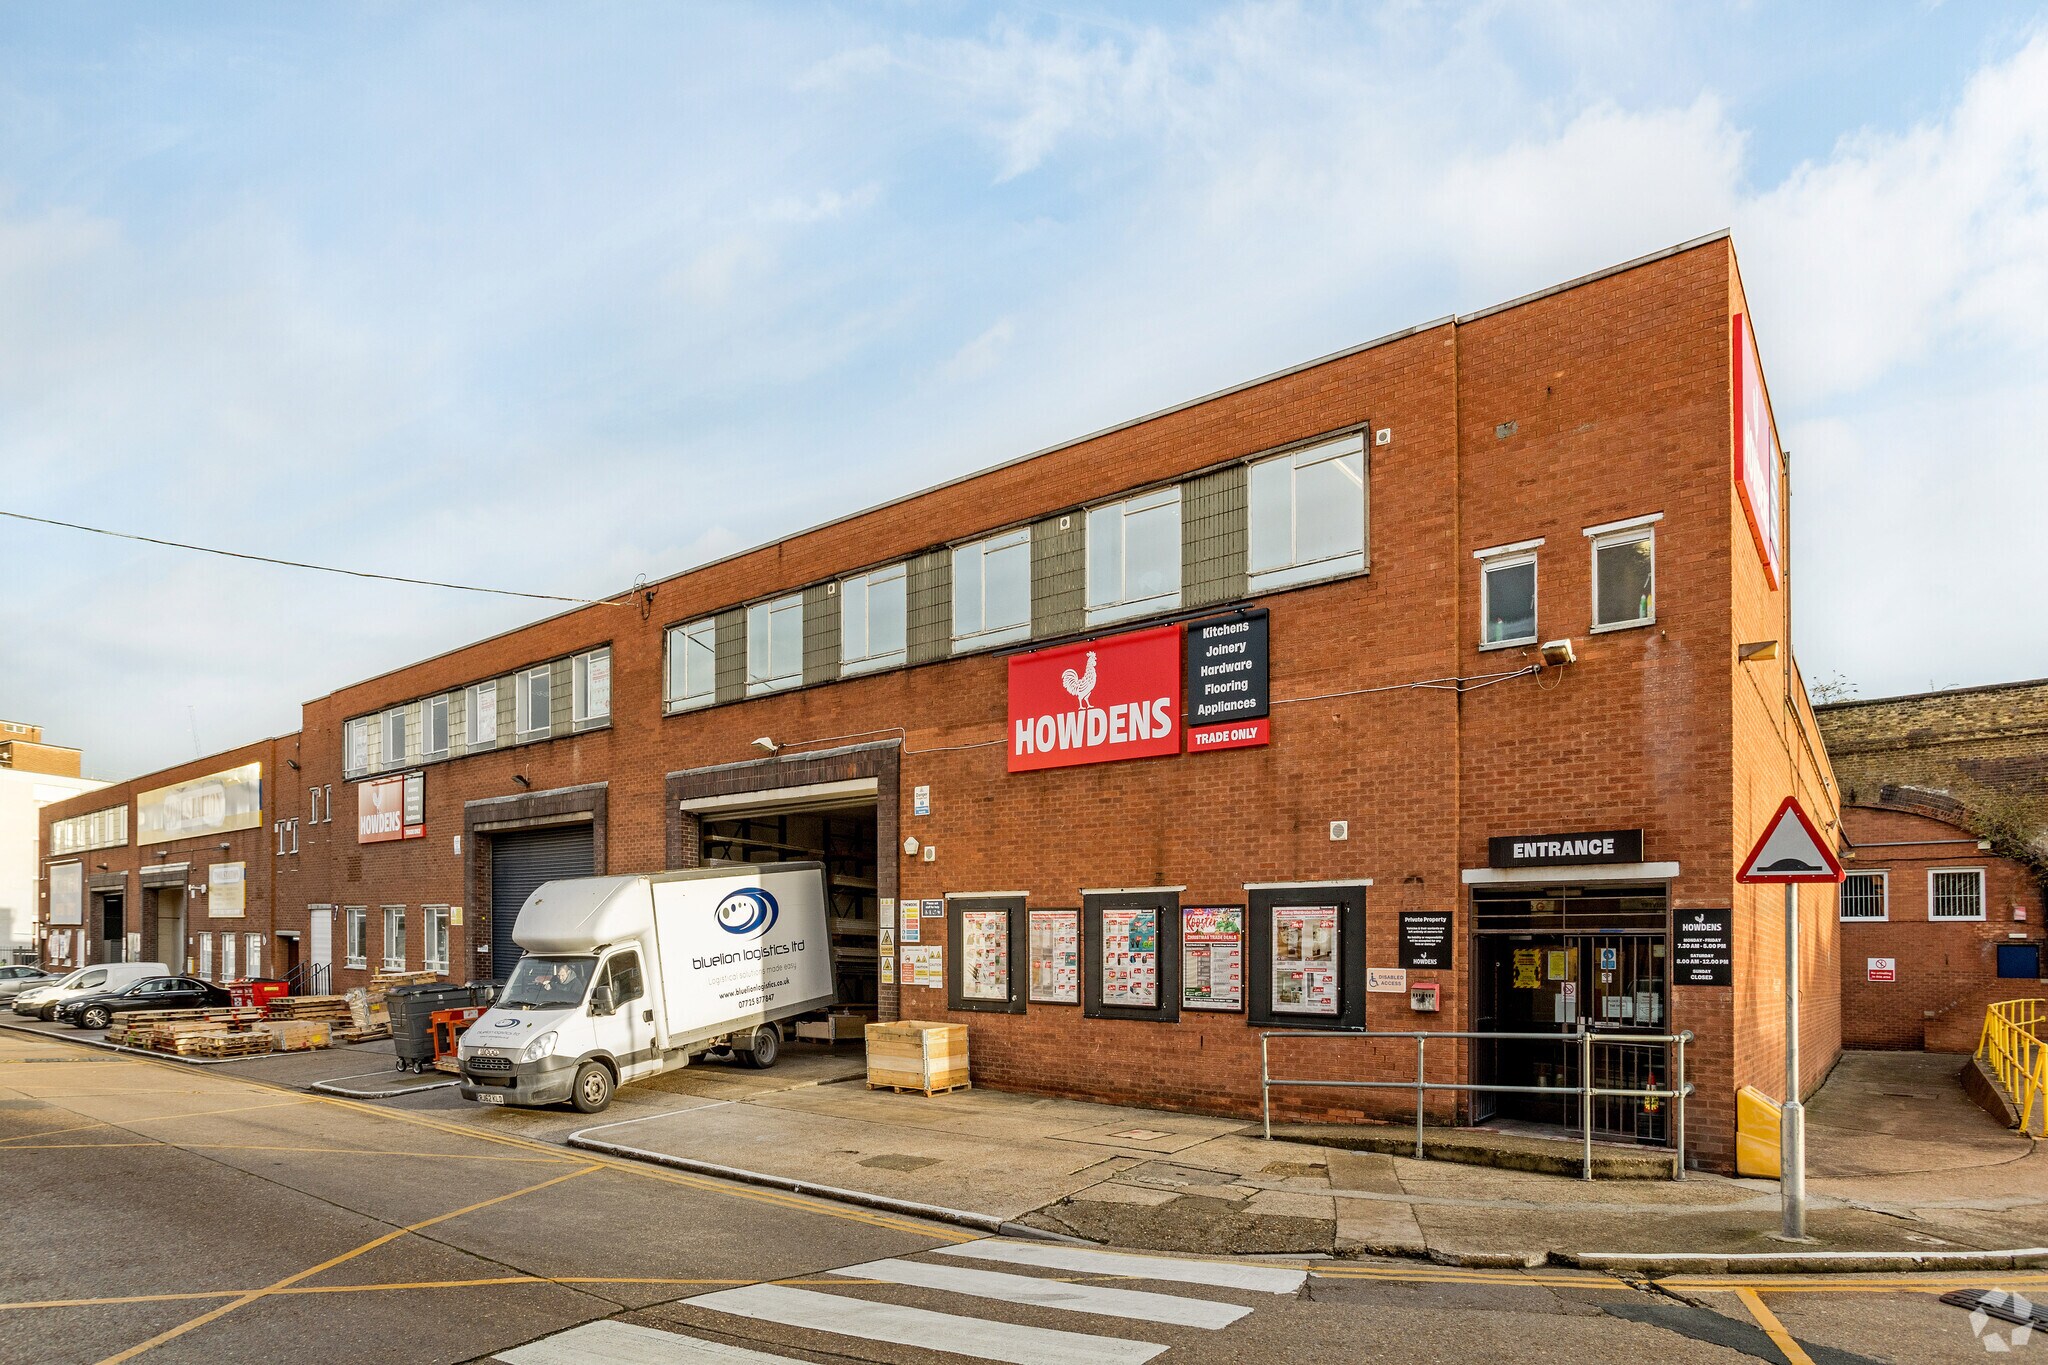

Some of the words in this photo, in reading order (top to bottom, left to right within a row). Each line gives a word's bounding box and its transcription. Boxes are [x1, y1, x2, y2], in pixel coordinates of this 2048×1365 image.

[1202, 622, 1250, 638] Kitchens
[1206, 642, 1246, 657] Joinery
[1200, 660, 1252, 676] Hardware
[1205, 680, 1248, 695] Flooring
[1198, 698, 1256, 716] Appliances
[1016, 698, 1172, 756] HOWDENS
[1196, 730, 1230, 744] TRADE
[1230, 727, 1258, 740] ONLY
[360, 811, 400, 834] HOWDENS
[1514, 838, 1614, 858] ENTRANCE
[692, 953, 740, 970] bluelion
[744, 944, 790, 961] logistics
[792, 940, 805, 952] ltd
[766, 962, 782, 973] made
[784, 961, 797, 971] easy
[719, 978, 790, 999] www.bluelionlogistics.co.uk
